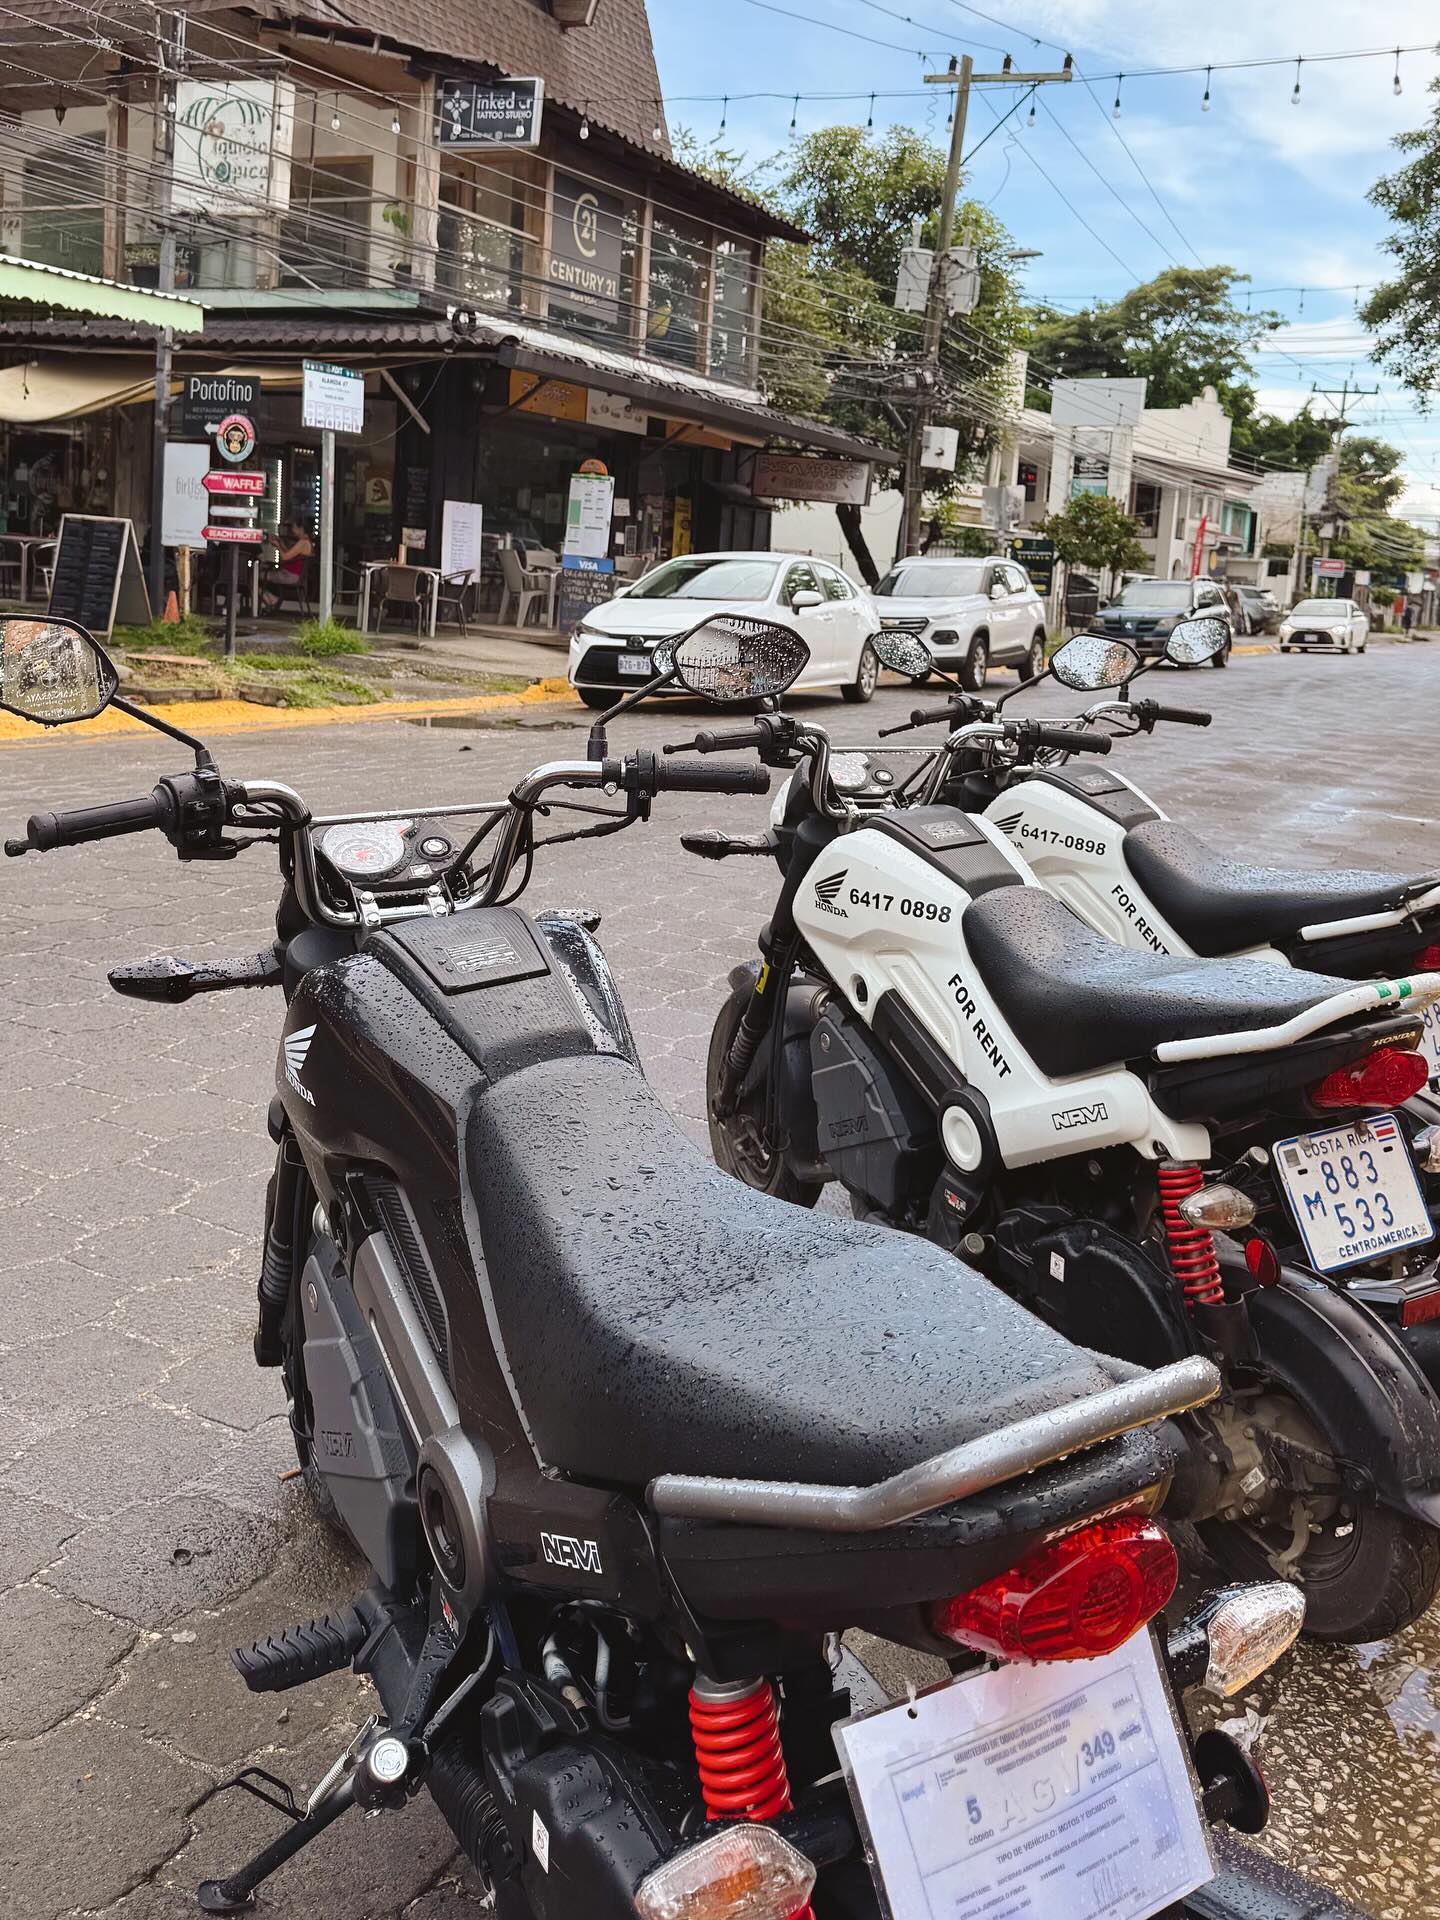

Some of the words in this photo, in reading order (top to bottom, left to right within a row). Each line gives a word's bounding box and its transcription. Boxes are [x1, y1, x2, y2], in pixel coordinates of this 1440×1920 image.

[476, 91, 515, 110] inked
[476, 110, 504, 119] TATTOO
[505, 110, 532, 119] STUDIO
[550, 259, 604, 293] CENTURY
[606, 281, 617, 298] 21
[190, 377, 253, 402] Portofino
[222, 477, 264, 491] WAFFLE
[578, 560, 599, 571] VISA
[1020, 823, 1107, 857] 6417-0898
[814, 900, 849, 919] HONDA
[848, 887, 895, 912] 6417
[899, 898, 953, 923] 0898
[1111, 884, 1138, 919] FOR
[1133, 914, 1171, 956] RENT
[947, 973, 976, 1021] FOR
[972, 1018, 1013, 1079] RENT
[1371, 1030, 1417, 1048] HONDA
[285, 1064, 317, 1107] HONDA
[1303, 1136, 1342, 1159] COSTA
[1348, 1127, 1377, 1148] RICA
[1320, 1150, 1379, 1195] 883
[1303, 1190, 1328, 1221] M
[1333, 1192, 1394, 1238] 533
[1338, 1225, 1419, 1258] CENTROAMERICA
[1042, 1495, 1145, 1544] HONDA
[966, 1795, 982, 1825] 5
[1080, 1730, 1116, 1767] 349
[968, 1828, 995, 1846] CÓDIGO
[996, 1850, 1013, 1865] TIPO
[1012, 1846, 1024, 1858] DE
[1058, 1817, 1081, 1834] MOTOS
